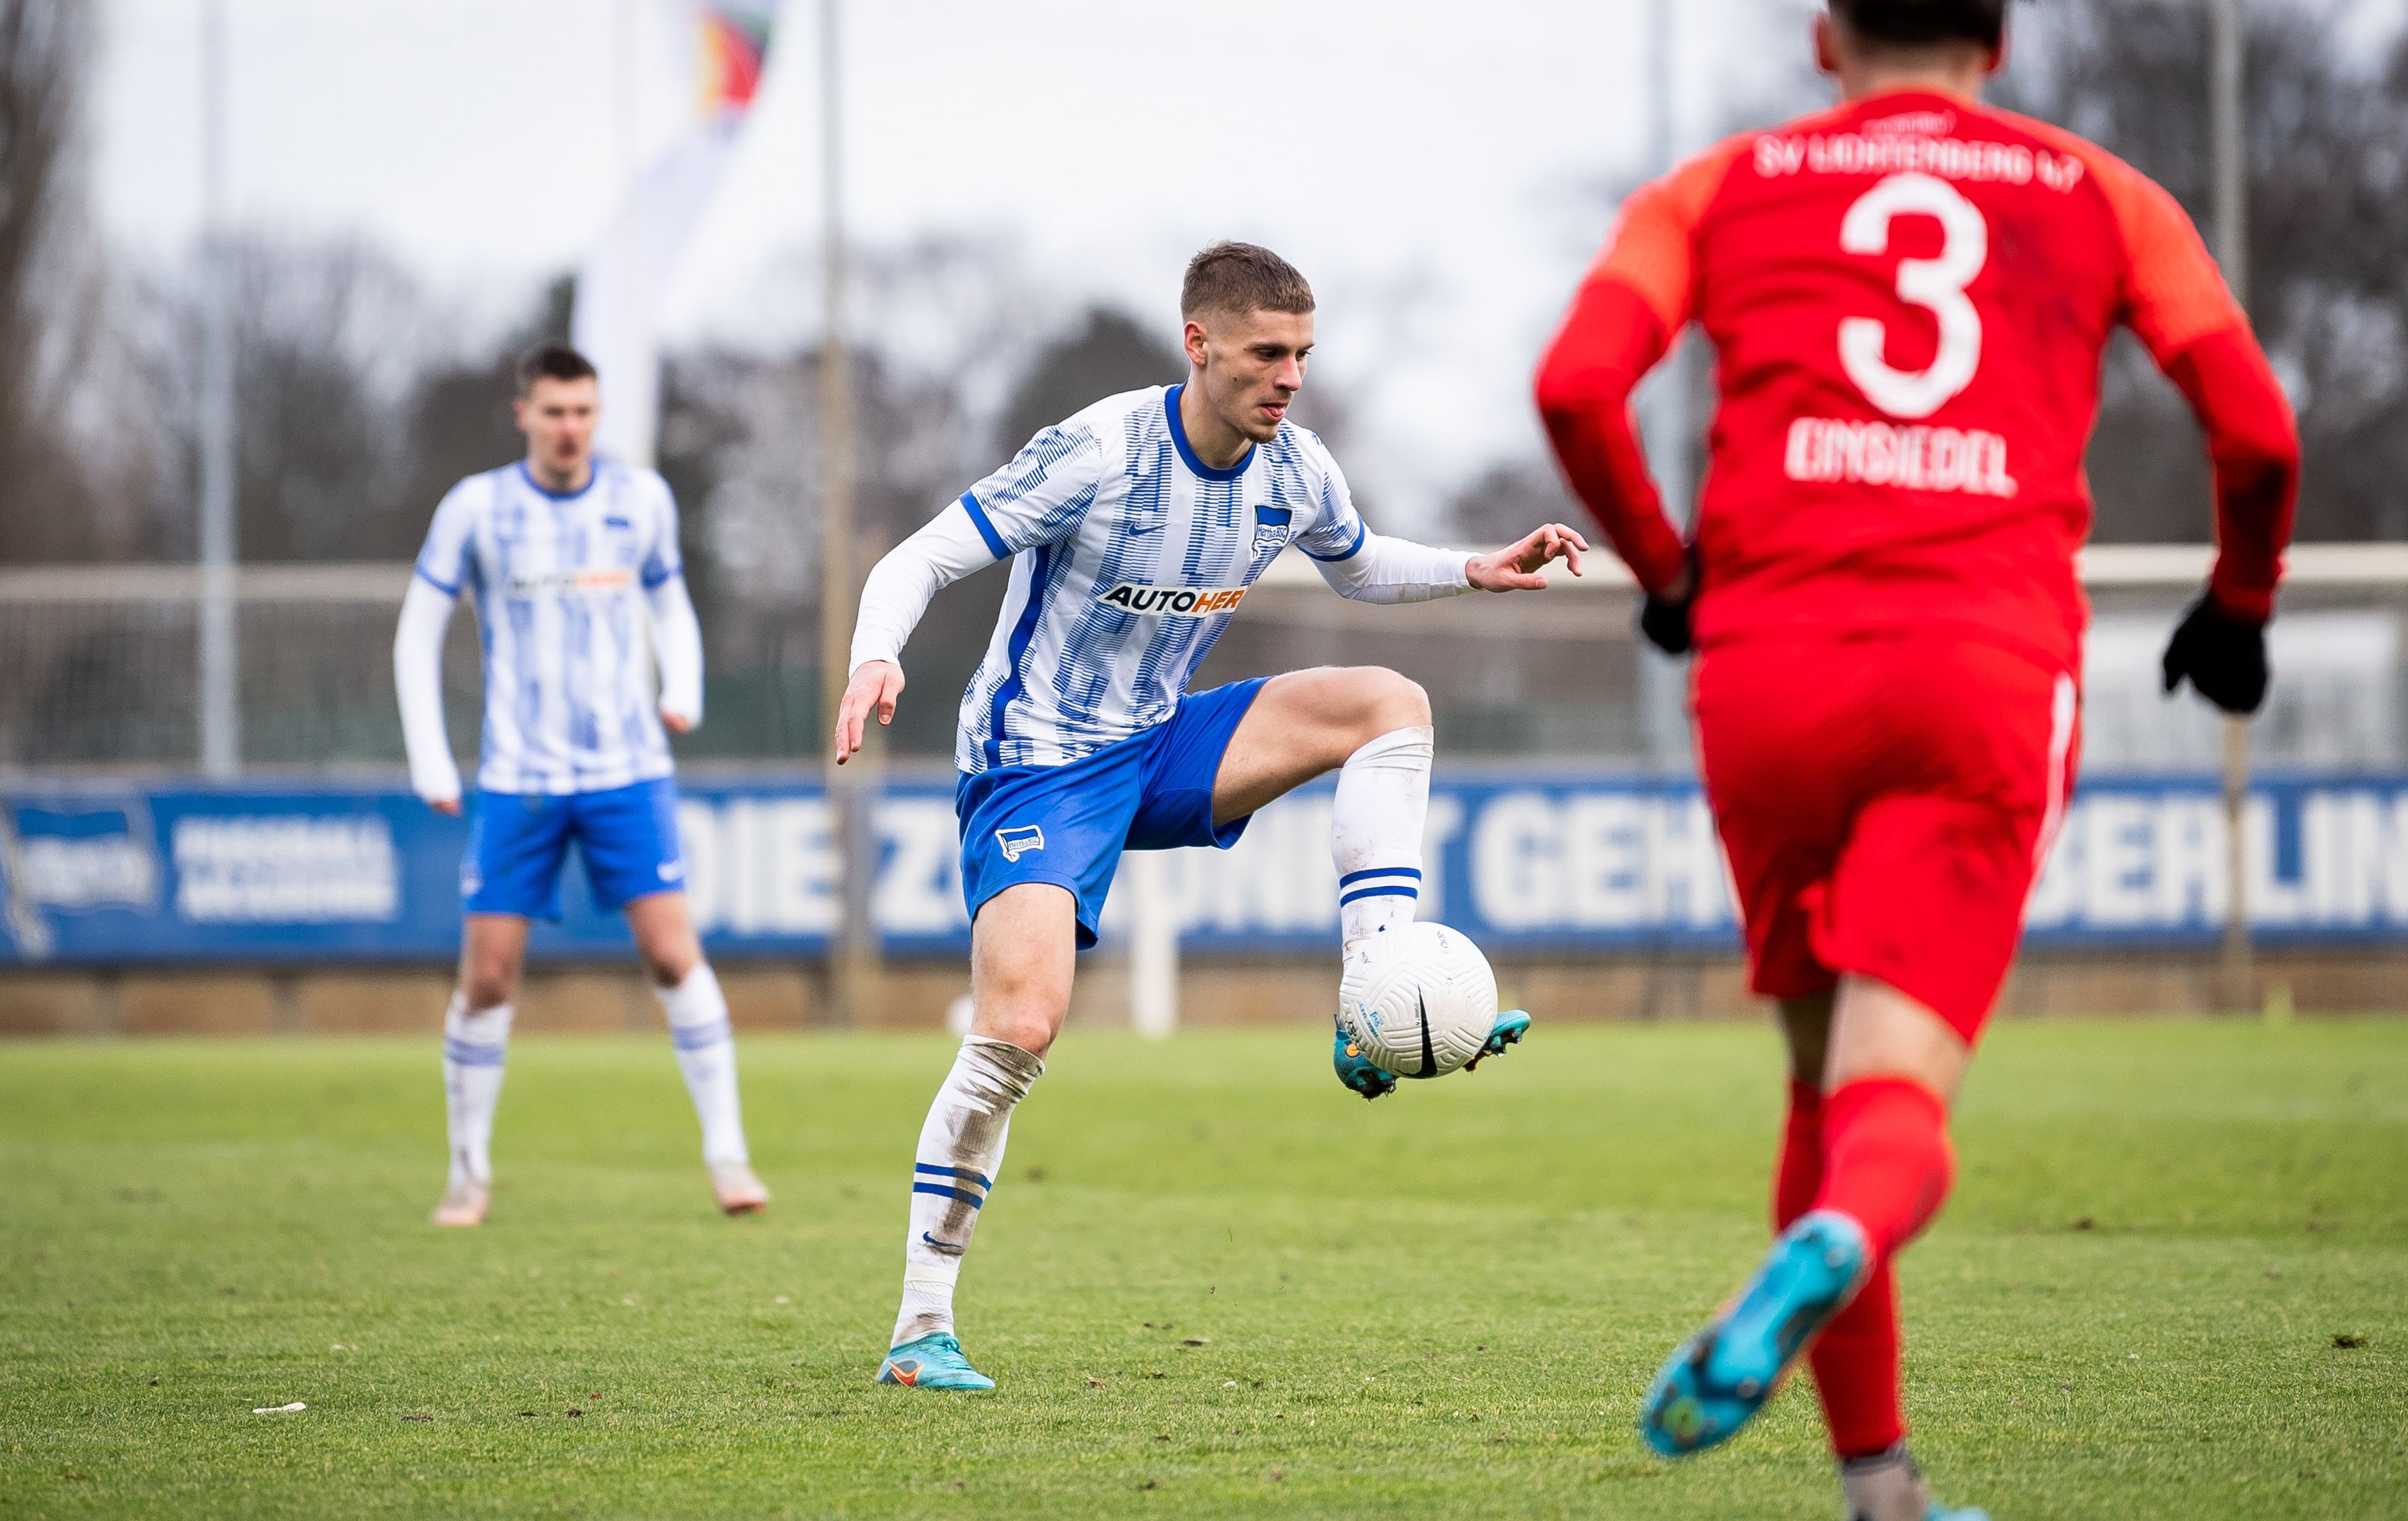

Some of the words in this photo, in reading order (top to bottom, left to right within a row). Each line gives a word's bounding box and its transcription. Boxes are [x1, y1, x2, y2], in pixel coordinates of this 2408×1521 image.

[1837, 172, 1989, 420] 3
[1258, 526, 1276, 539] Hertha
[1276, 527, 1287, 539] BSC
